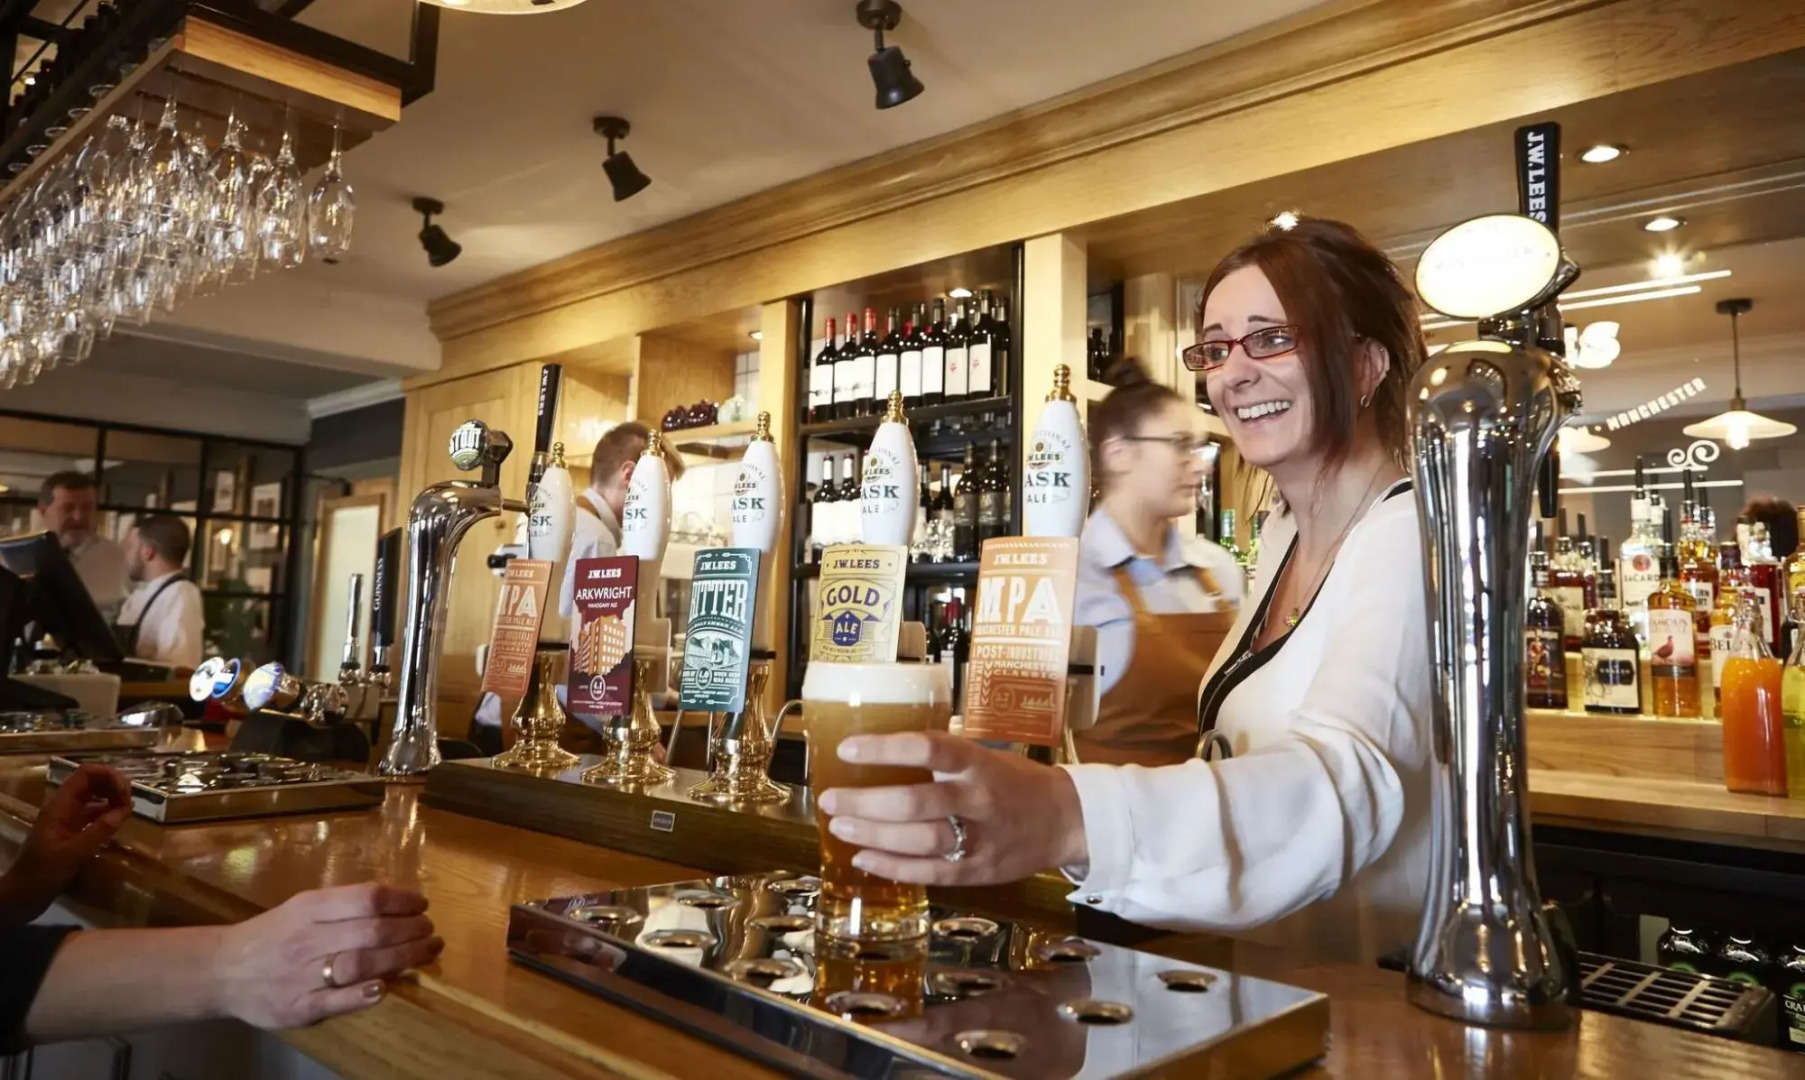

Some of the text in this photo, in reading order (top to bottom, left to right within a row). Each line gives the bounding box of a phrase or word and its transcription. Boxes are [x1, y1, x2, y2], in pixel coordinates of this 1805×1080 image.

[1025, 471, 1072, 488] ASK
[861, 485, 900, 500] ASK
[732, 497, 766, 510] SK
[531, 515, 553, 527] SK
[624, 507, 648, 520] SK
[832, 559, 881, 570] J.W.LEES
[374, 557, 383, 611] GUINNESS
[575, 585, 633, 600] ARKWRIGHT
[826, 584, 880, 607] GOLD
[976, 576, 1064, 624] MPA
[688, 579, 749, 624] BITTER
[835, 621, 858, 634] ALE
[1785, 1000, 1805, 1012] CRA
